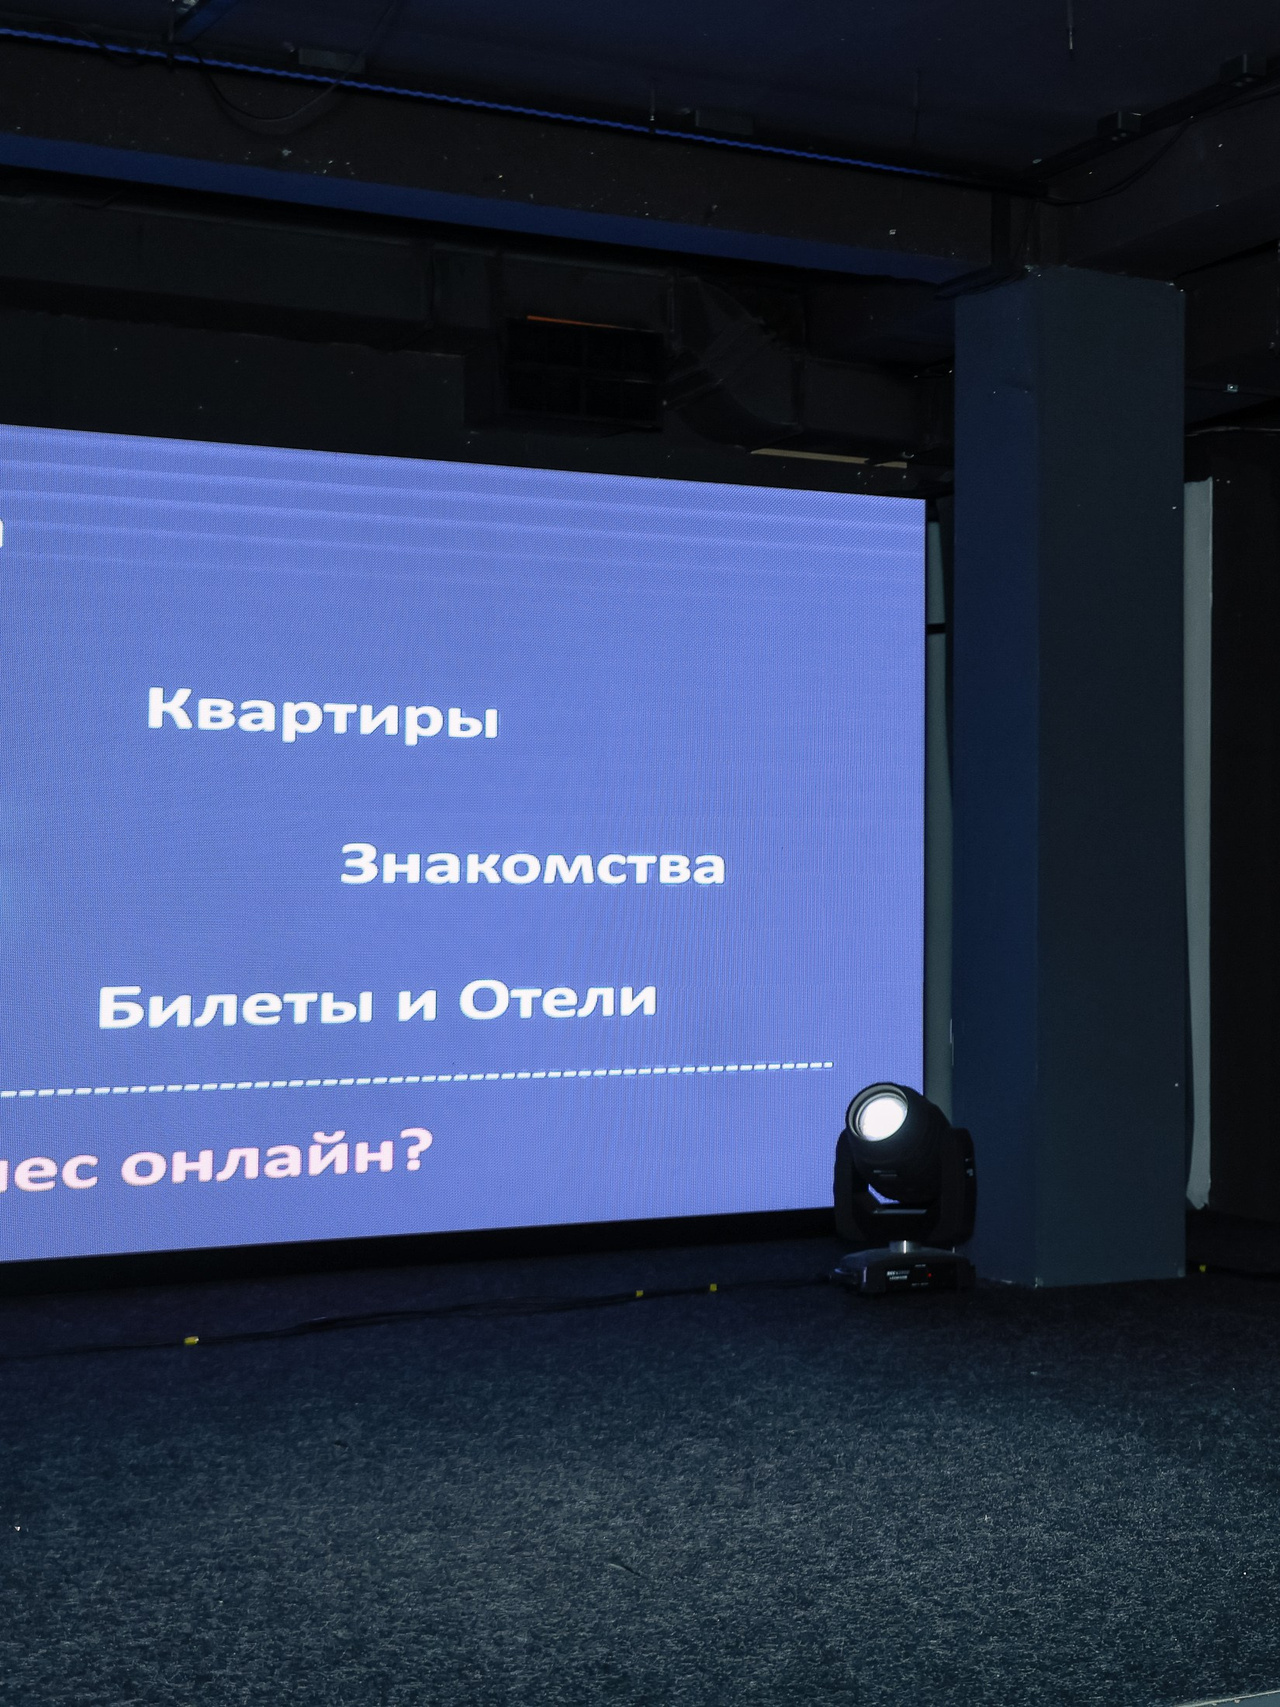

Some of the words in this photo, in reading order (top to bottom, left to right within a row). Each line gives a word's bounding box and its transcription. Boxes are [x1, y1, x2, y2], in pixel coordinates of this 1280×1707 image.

[147, 687, 499, 746] Квартиры
[340, 843, 726, 884] Знакомства
[98, 986, 373, 1029] Билеты
[397, 989, 437, 1022] и
[458, 979, 657, 1020] Отели
[0, 1154, 99, 1193] ес
[121, 1127, 433, 1187] онлайн?
